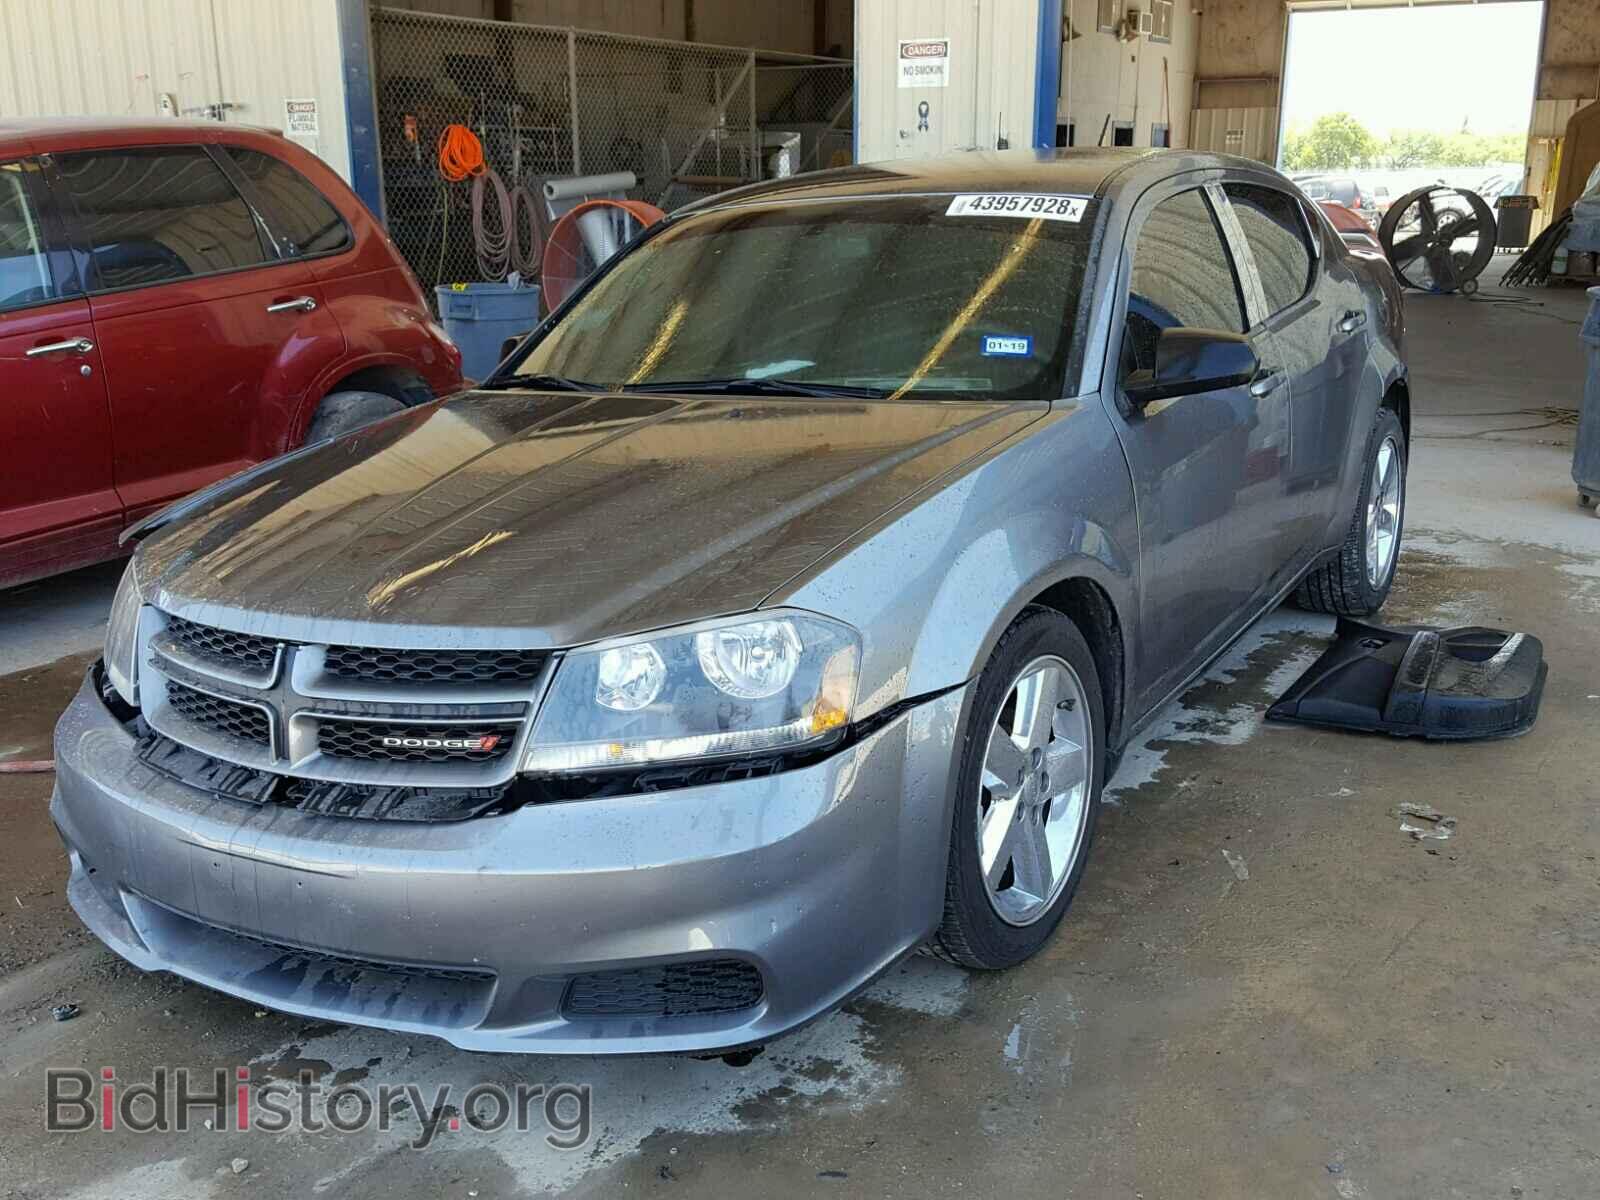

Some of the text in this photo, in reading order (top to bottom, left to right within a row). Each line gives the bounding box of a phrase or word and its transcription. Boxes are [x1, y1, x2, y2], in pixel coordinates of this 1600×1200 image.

[908, 45, 944, 56] DANGER
[903, 65, 913, 76] NO
[988, 341, 1026, 350] 01-19
[383, 737, 482, 748] DODGE
